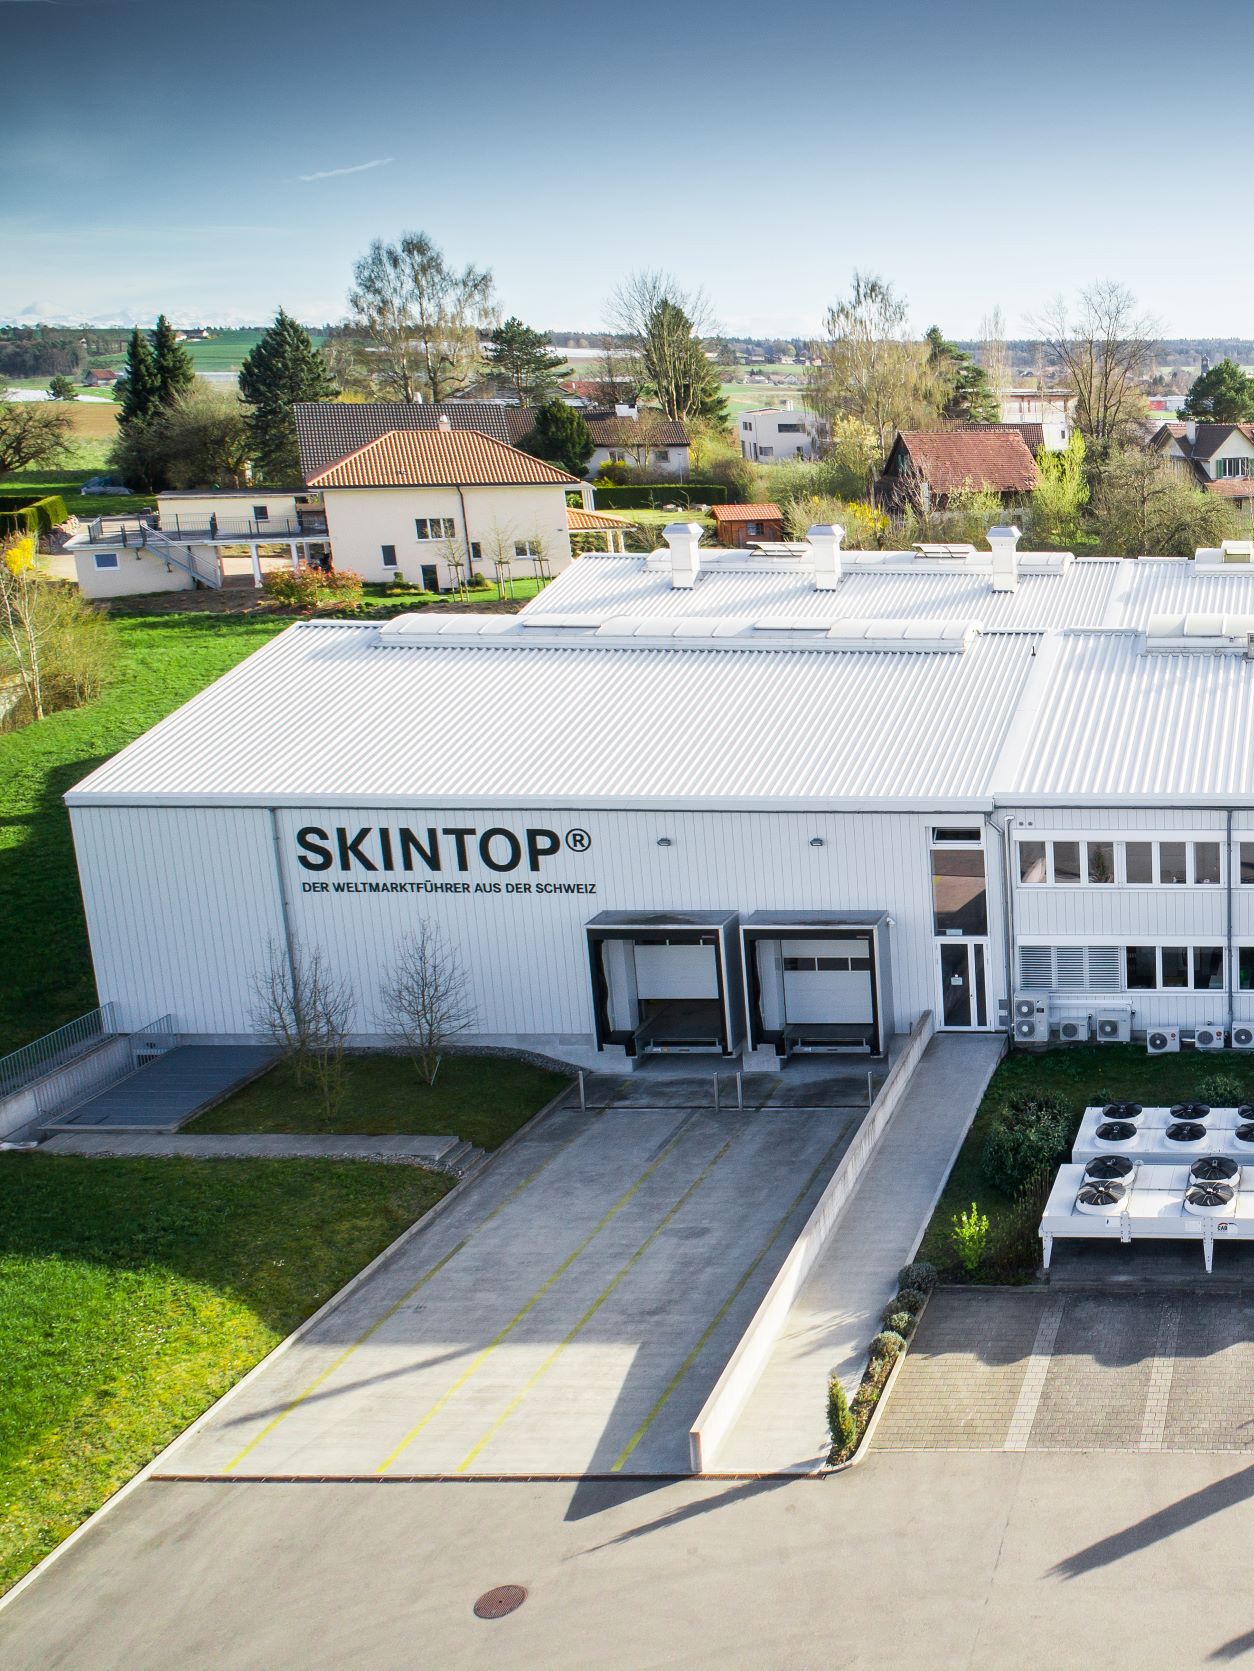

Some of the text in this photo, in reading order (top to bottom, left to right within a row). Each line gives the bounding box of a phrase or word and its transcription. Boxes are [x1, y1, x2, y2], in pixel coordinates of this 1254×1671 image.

[302, 880, 597, 894] DER WELTMARKTFÜHRER AUS DER SCHWEIZ
